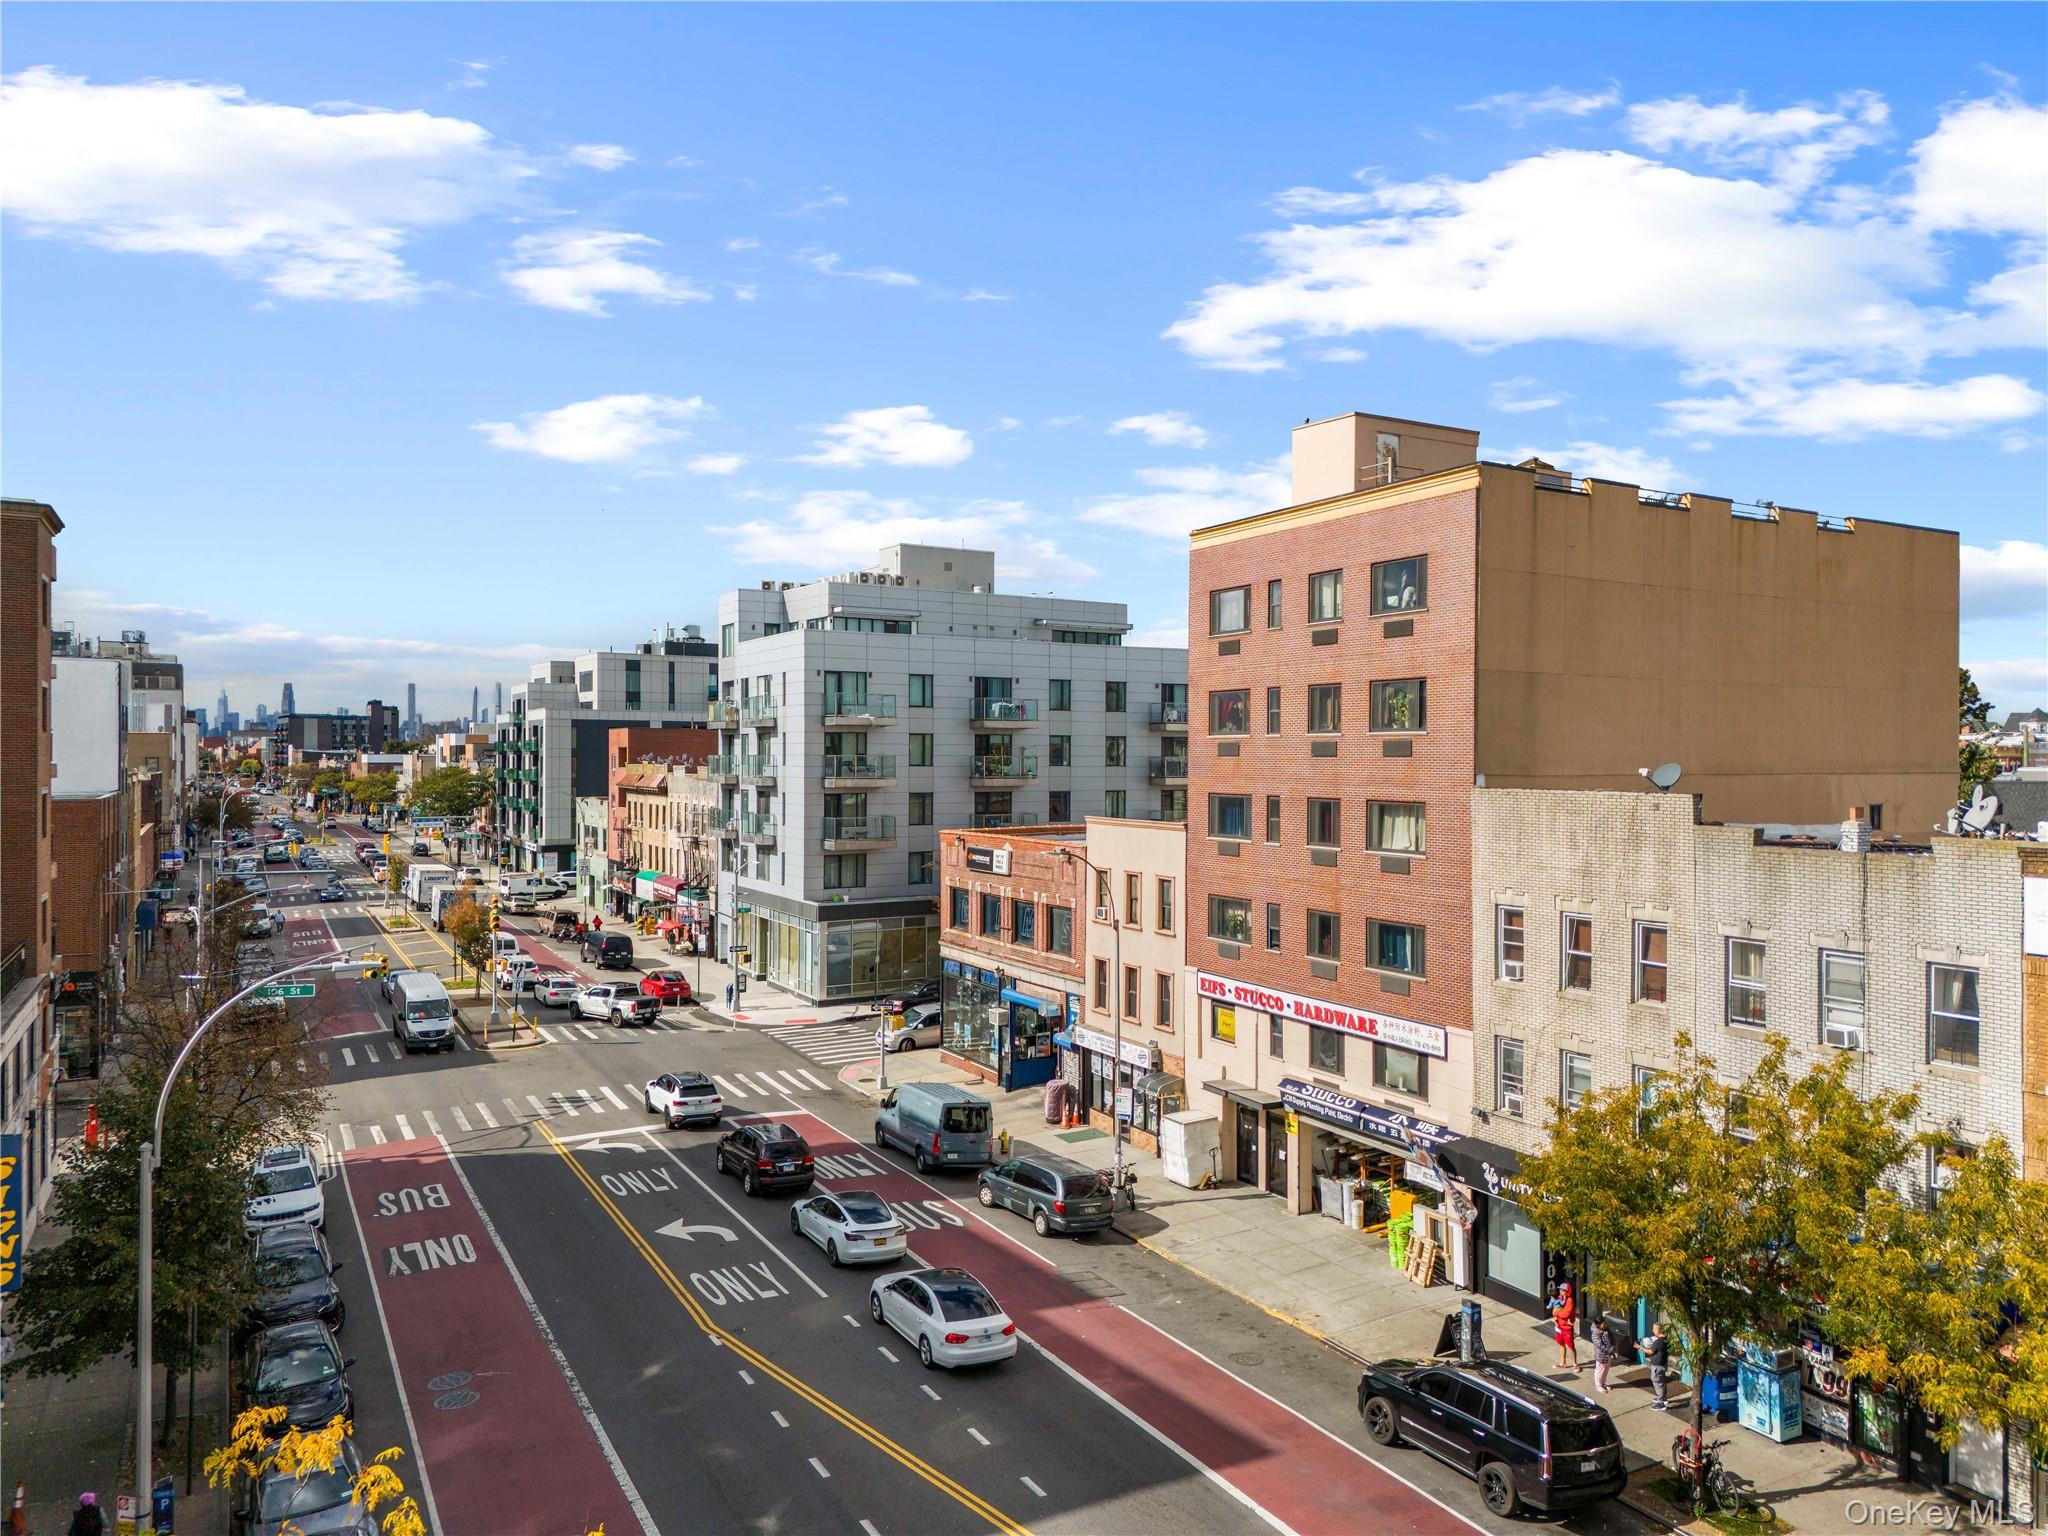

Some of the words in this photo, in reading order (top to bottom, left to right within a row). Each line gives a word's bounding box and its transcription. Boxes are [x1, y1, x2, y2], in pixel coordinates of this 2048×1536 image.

[290, 987, 301, 996] St
[1199, 977, 1227, 998] EIFS
[1234, 986, 1285, 1012] STUCCO
[1294, 1001, 1379, 1036] HARDWARE
[600, 1167, 679, 1197] ONLY
[378, 1183, 451, 1216] BUS
[388, 1234, 477, 1278] ONLY
[689, 1261, 790, 1306] ONLY
[161, 1498, 170, 1510] P
